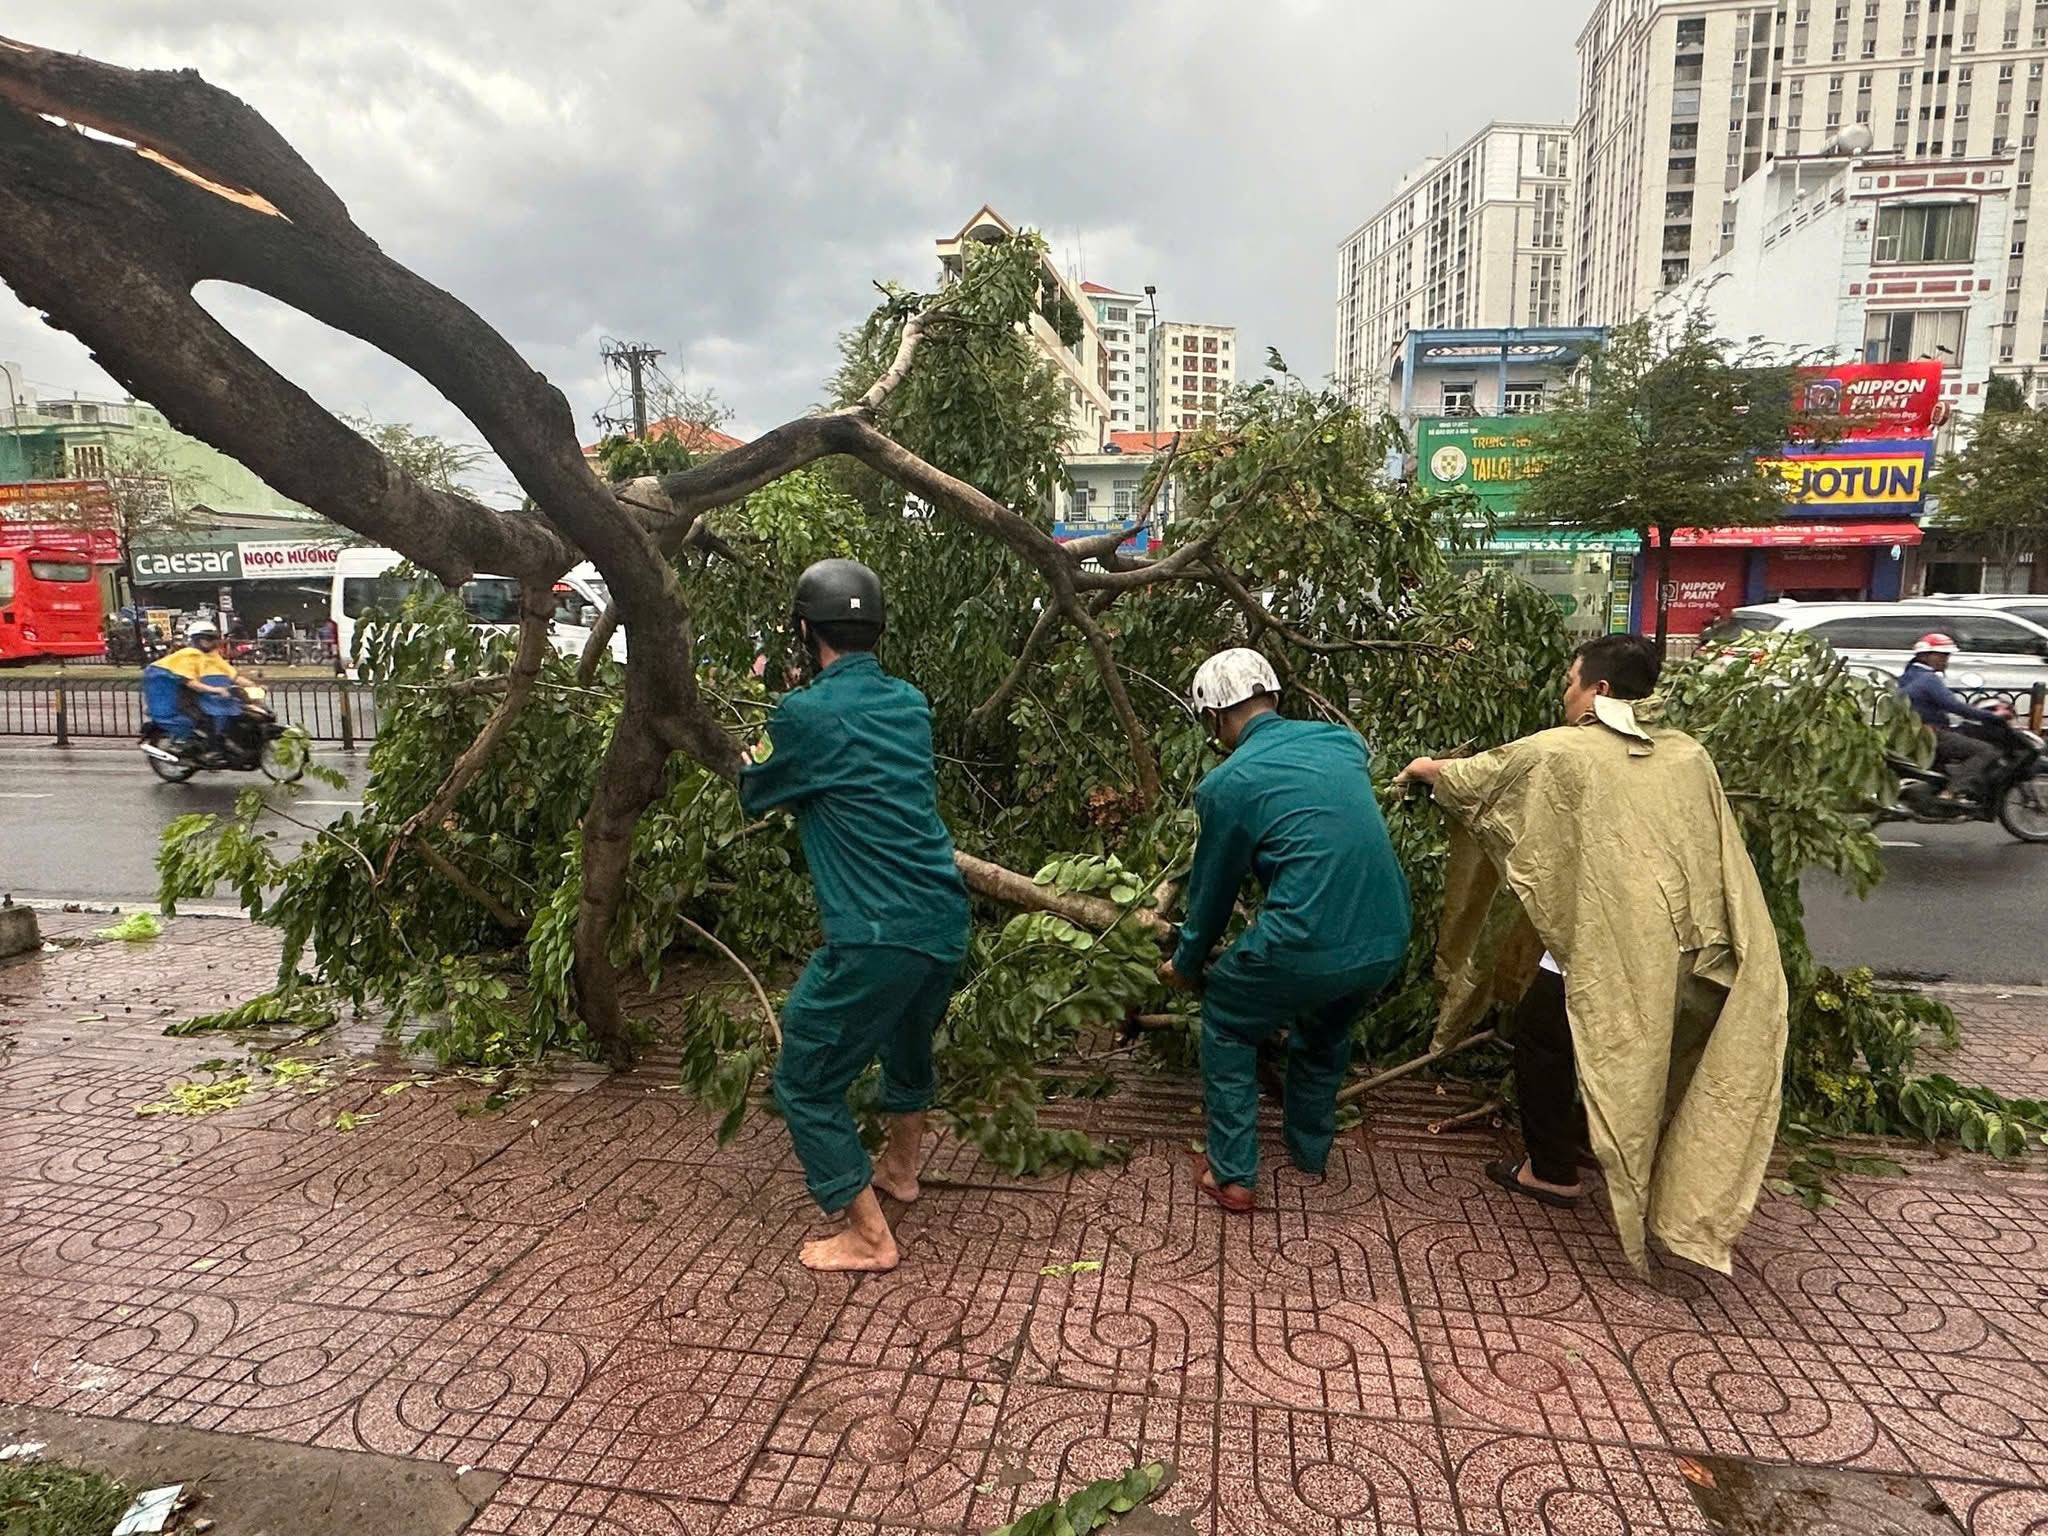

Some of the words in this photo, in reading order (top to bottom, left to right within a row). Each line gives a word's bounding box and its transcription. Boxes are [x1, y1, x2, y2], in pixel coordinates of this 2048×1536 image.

[1847, 379, 1927, 395] NIPPON
[1795, 465, 1916, 499] JOTUN
[135, 550, 234, 575] caesar
[244, 552, 284, 568] NGỌC
[287, 548, 338, 564] HƯƠNG
[1681, 582, 1726, 591] NIPPON
[1683, 591, 1718, 600] PAINT
